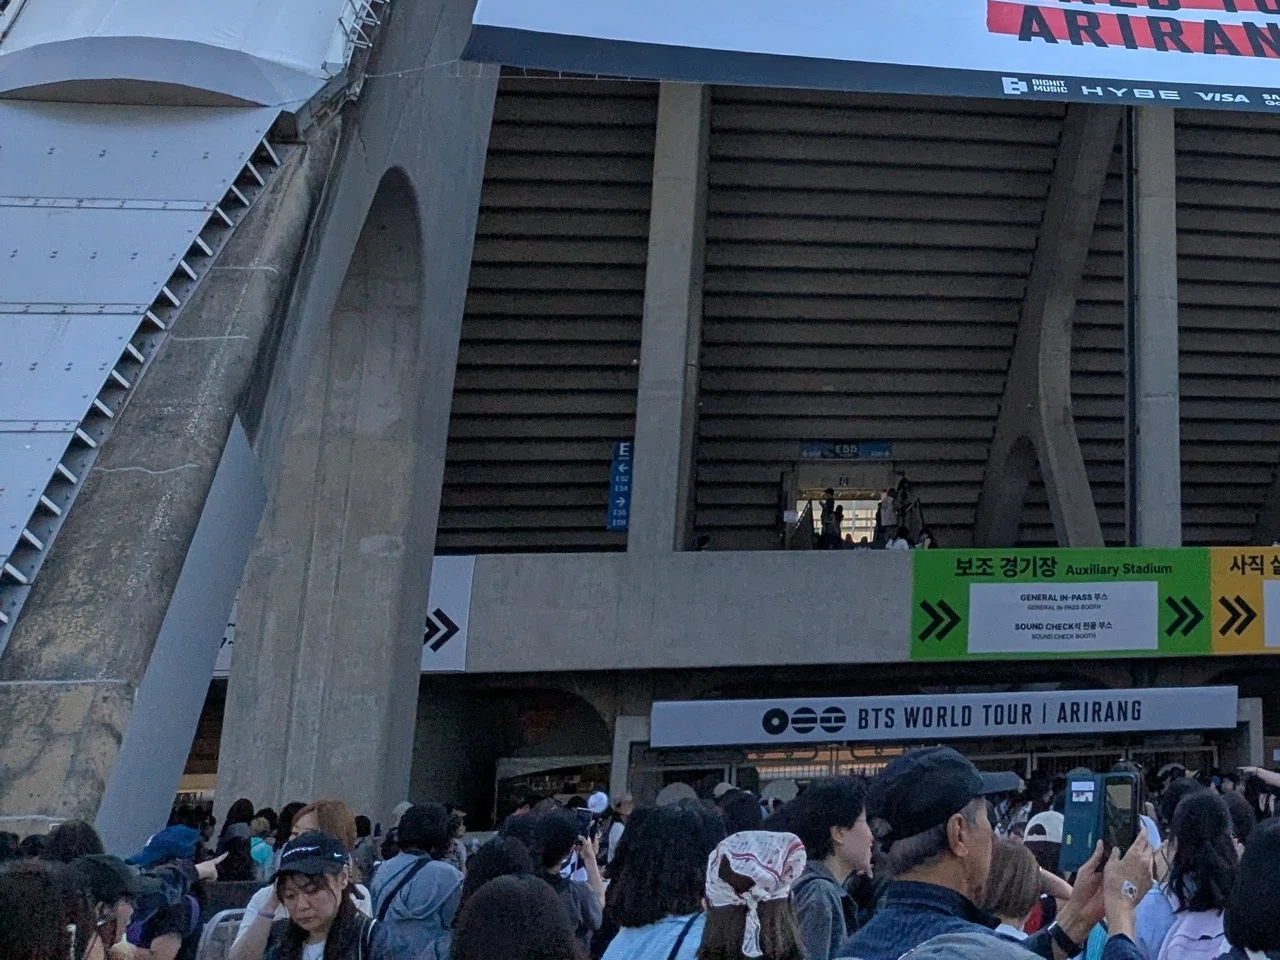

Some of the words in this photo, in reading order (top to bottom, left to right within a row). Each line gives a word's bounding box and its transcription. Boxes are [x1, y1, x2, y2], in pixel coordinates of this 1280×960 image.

[1031, 78, 1066, 88] BIGHIT
[1033, 84, 1068, 93] MUSIC
[1081, 85, 1181, 101] HYBE
[1194, 91, 1250, 103] VISA
[620, 442, 630, 456] E
[955, 556, 995, 577] 보조
[1000, 556, 1057, 578] 경기장
[1066, 563, 1119, 578] Auxiliary
[1122, 562, 1172, 575] Stadium
[1229, 554, 1265, 575] 사직
[1060, 593, 1093, 601] IN-PASS
[1094, 593, 1108, 601] 부스
[1015, 622, 1044, 631] SOUND
[1045, 622, 1081, 631] CHECK석
[1099, 621, 1113, 629] 부스
[858, 707, 895, 729] BTS
[904, 705, 972, 729] WORLD
[983, 703, 1032, 725] TOUR
[1057, 700, 1142, 723] ARIRANG
